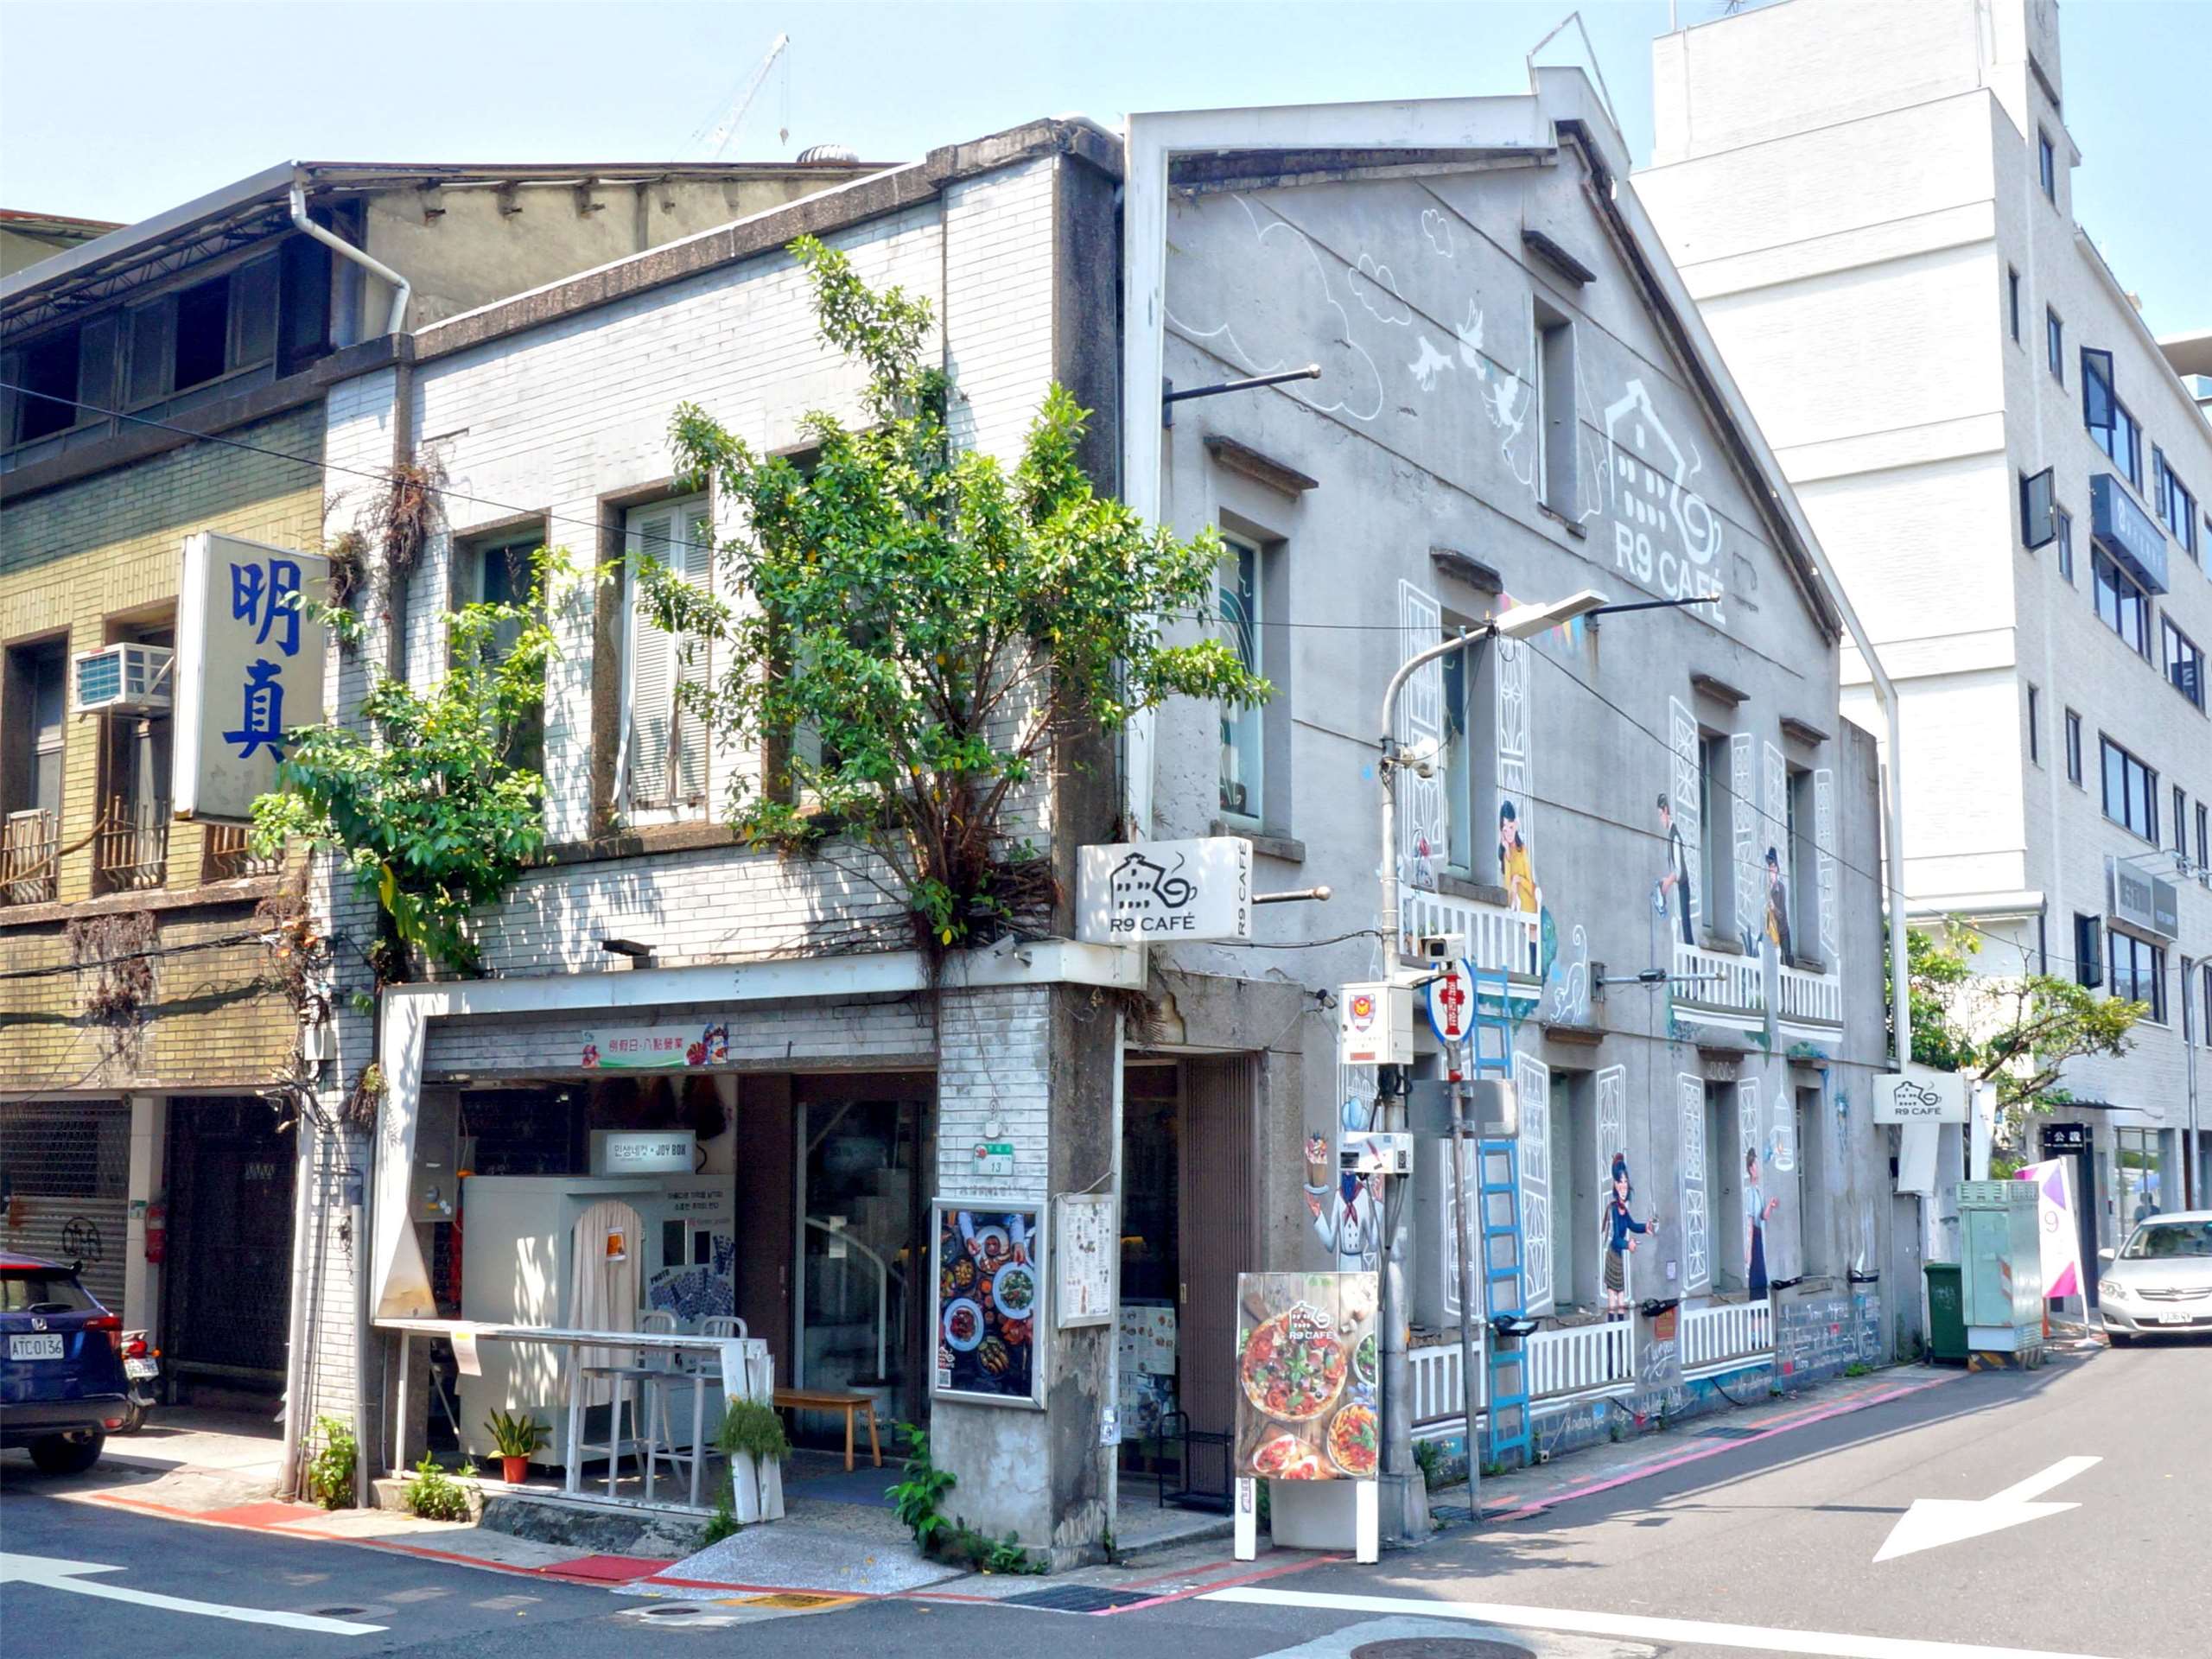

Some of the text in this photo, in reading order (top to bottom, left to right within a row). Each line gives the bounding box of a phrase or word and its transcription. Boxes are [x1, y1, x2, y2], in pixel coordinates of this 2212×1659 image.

[1614, 519, 1726, 626] R9 CAFÉ
[221, 558, 302, 764] 明真
[1237, 841, 1248, 937] R9 CAFÉ
[1110, 912, 1196, 933] R9 CAFÉ
[656, 1144, 670, 1156] JOY
[671, 1143, 686, 1155] BOX
[991, 1161, 1002, 1173] 13
[1289, 1332, 1304, 1340] R9
